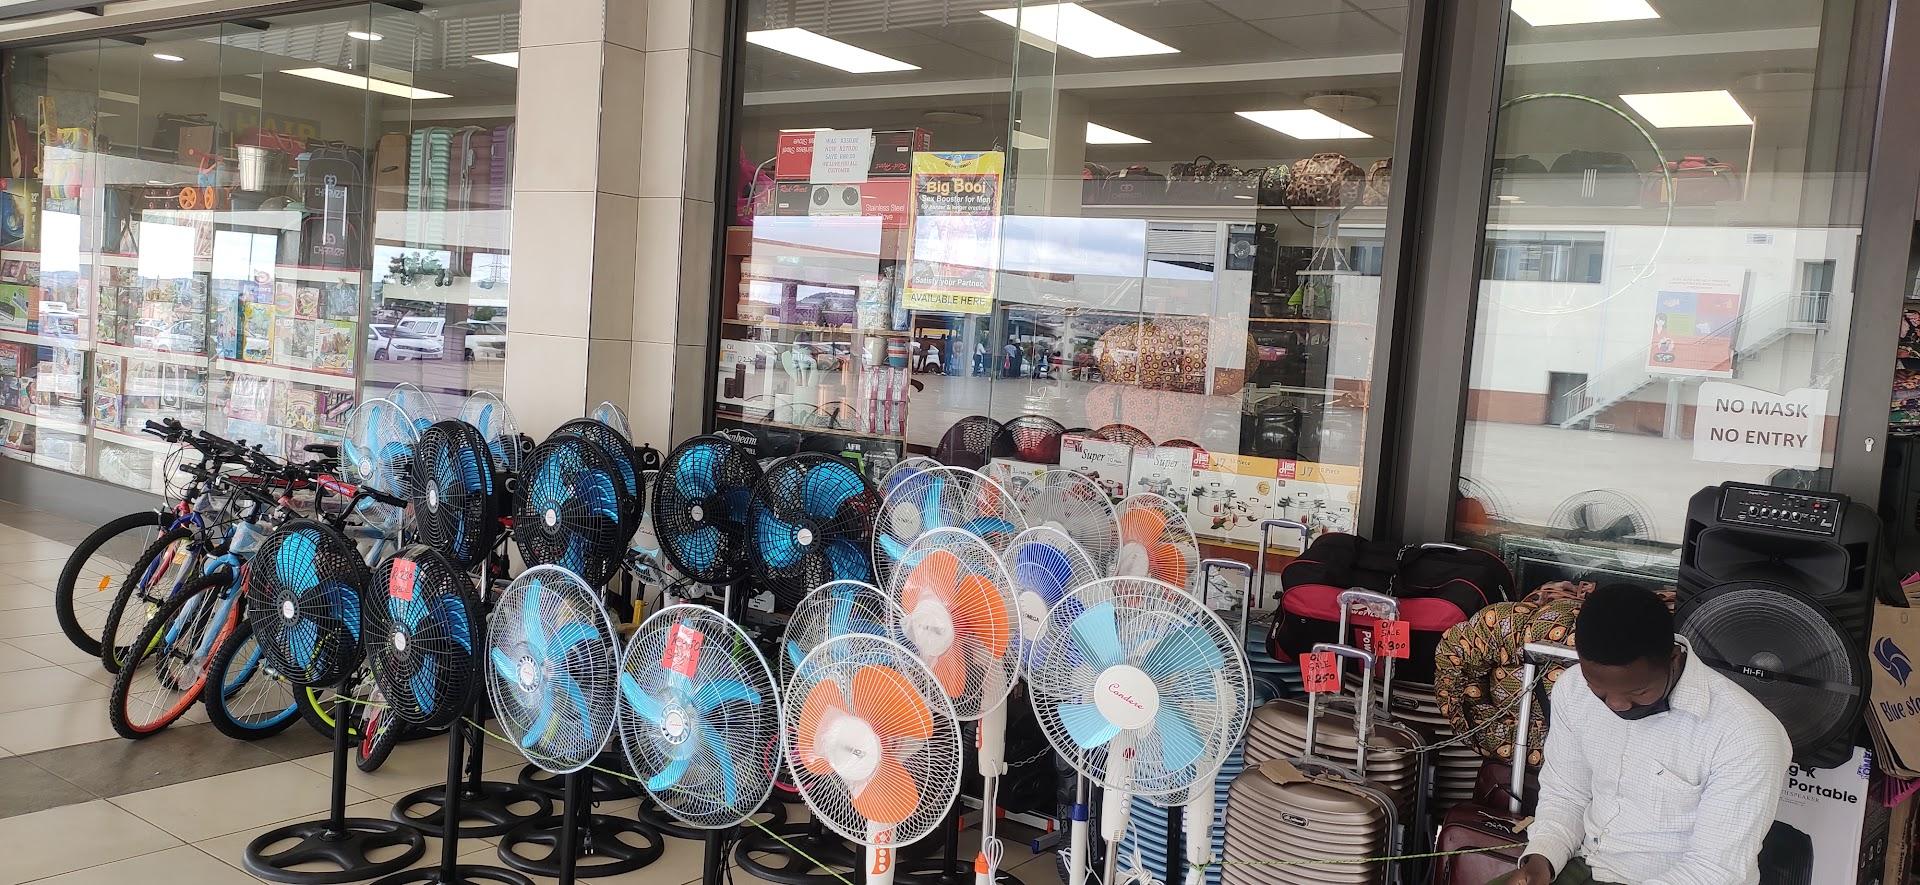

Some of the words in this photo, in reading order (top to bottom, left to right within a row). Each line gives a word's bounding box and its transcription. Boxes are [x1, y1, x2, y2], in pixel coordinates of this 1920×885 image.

[926, 180, 950, 196] Big
[921, 194, 935, 203] Sex
[940, 278, 956, 289] your
[911, 292, 958, 305] AVAILABLE
[960, 295, 986, 306] HERE
[1716, 398, 1745, 414] NO
[1751, 400, 1809, 419] MASK
[1710, 426, 1740, 443] NO
[1745, 430, 1808, 449] ENTRY
[1081, 448, 1106, 462] Super
[1154, 454, 1178, 470] Super
[1879, 700, 1907, 723] Blue
[1788, 777, 1859, 804] Portable
